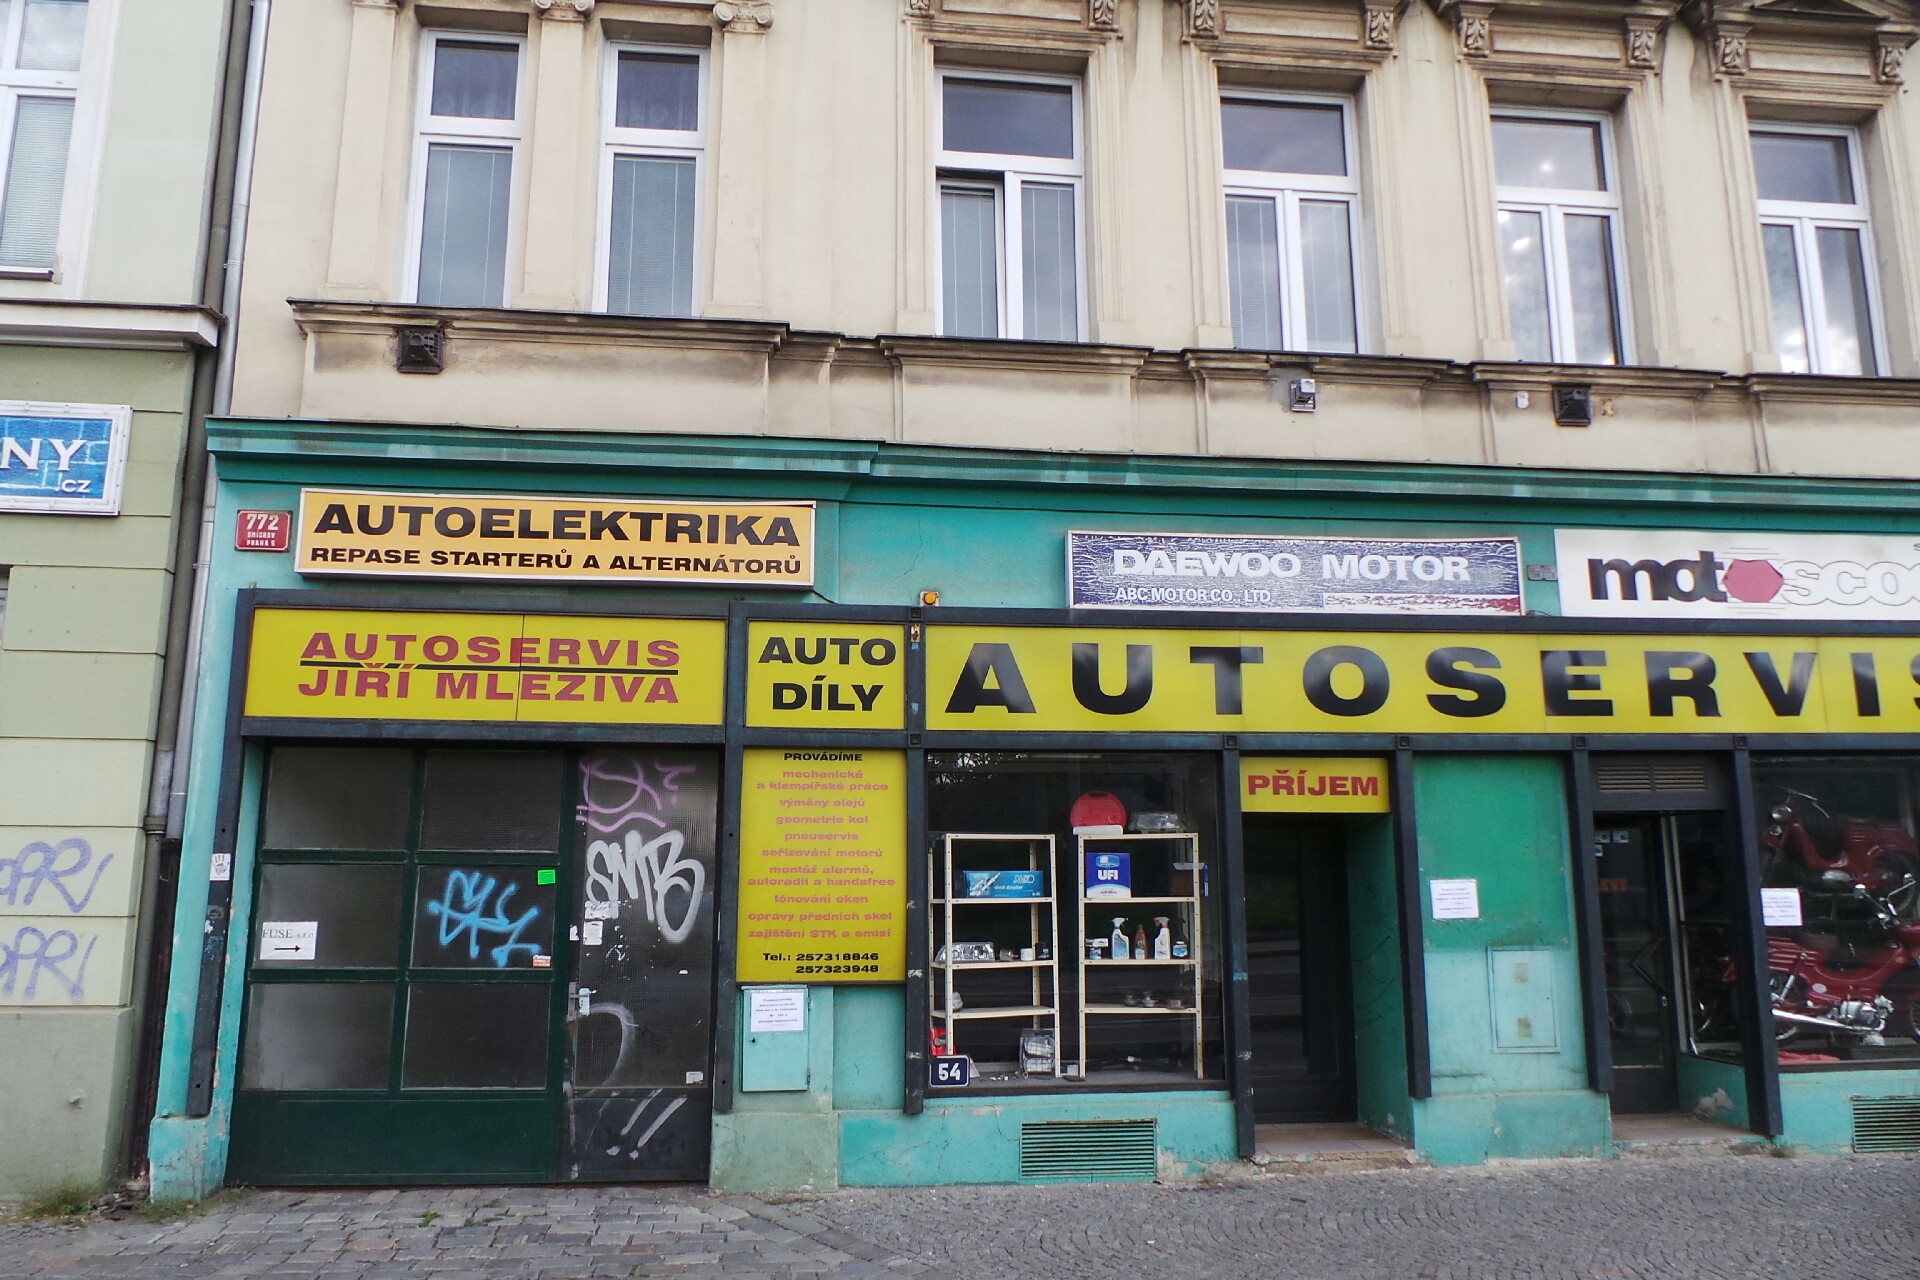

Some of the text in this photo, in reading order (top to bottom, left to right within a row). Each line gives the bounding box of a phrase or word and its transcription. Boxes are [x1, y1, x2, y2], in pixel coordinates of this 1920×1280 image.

[0, 437, 87, 471] NY
[246, 513, 280, 531] 772
[313, 503, 800, 547] AUTOELEKTRIKA
[246, 539, 269, 547] PRAHA
[311, 547, 801, 574] REPASE STARTERŮ A ALTERNÁTORŮ
[1113, 549, 1471, 581] DAEWOO MOTOR
[1115, 587, 1149, 601] ABC
[1150, 588, 1208, 602] MOTOR
[300, 631, 680, 667] AUTOSERVIS
[758, 636, 897, 666] AUTO
[298, 662, 679, 704] JIŘÍ MLEZIVA
[944, 642, 1920, 718] AUTOSERVI
[772, 675, 885, 712] DÍLY
[783, 752, 863, 762] PROVÁDÍME
[783, 769, 864, 779] mechanické
[756, 781, 766, 790] a
[849, 782, 889, 792] práce
[1247, 768, 1380, 798] PŘÍJEM
[779, 797, 830, 809] výměny
[775, 815, 869, 826] geometrie kol
[784, 832, 859, 842] pneuservis
[769, 864, 818, 875] montáž
[1097, 869, 1119, 881] UFI
[827, 877, 895, 887] handsfree
[835, 895, 869, 904] oken
[748, 912, 795, 922] opravy
[864, 912, 892, 921] skel
[262, 929, 294, 939] FUSE
[809, 929, 838, 939] STK
[841, 931, 851, 939] a
[763, 952, 879, 962] Tel.: 257318846
[795, 964, 879, 974] 257323948
[937, 1062, 962, 1081] 54
